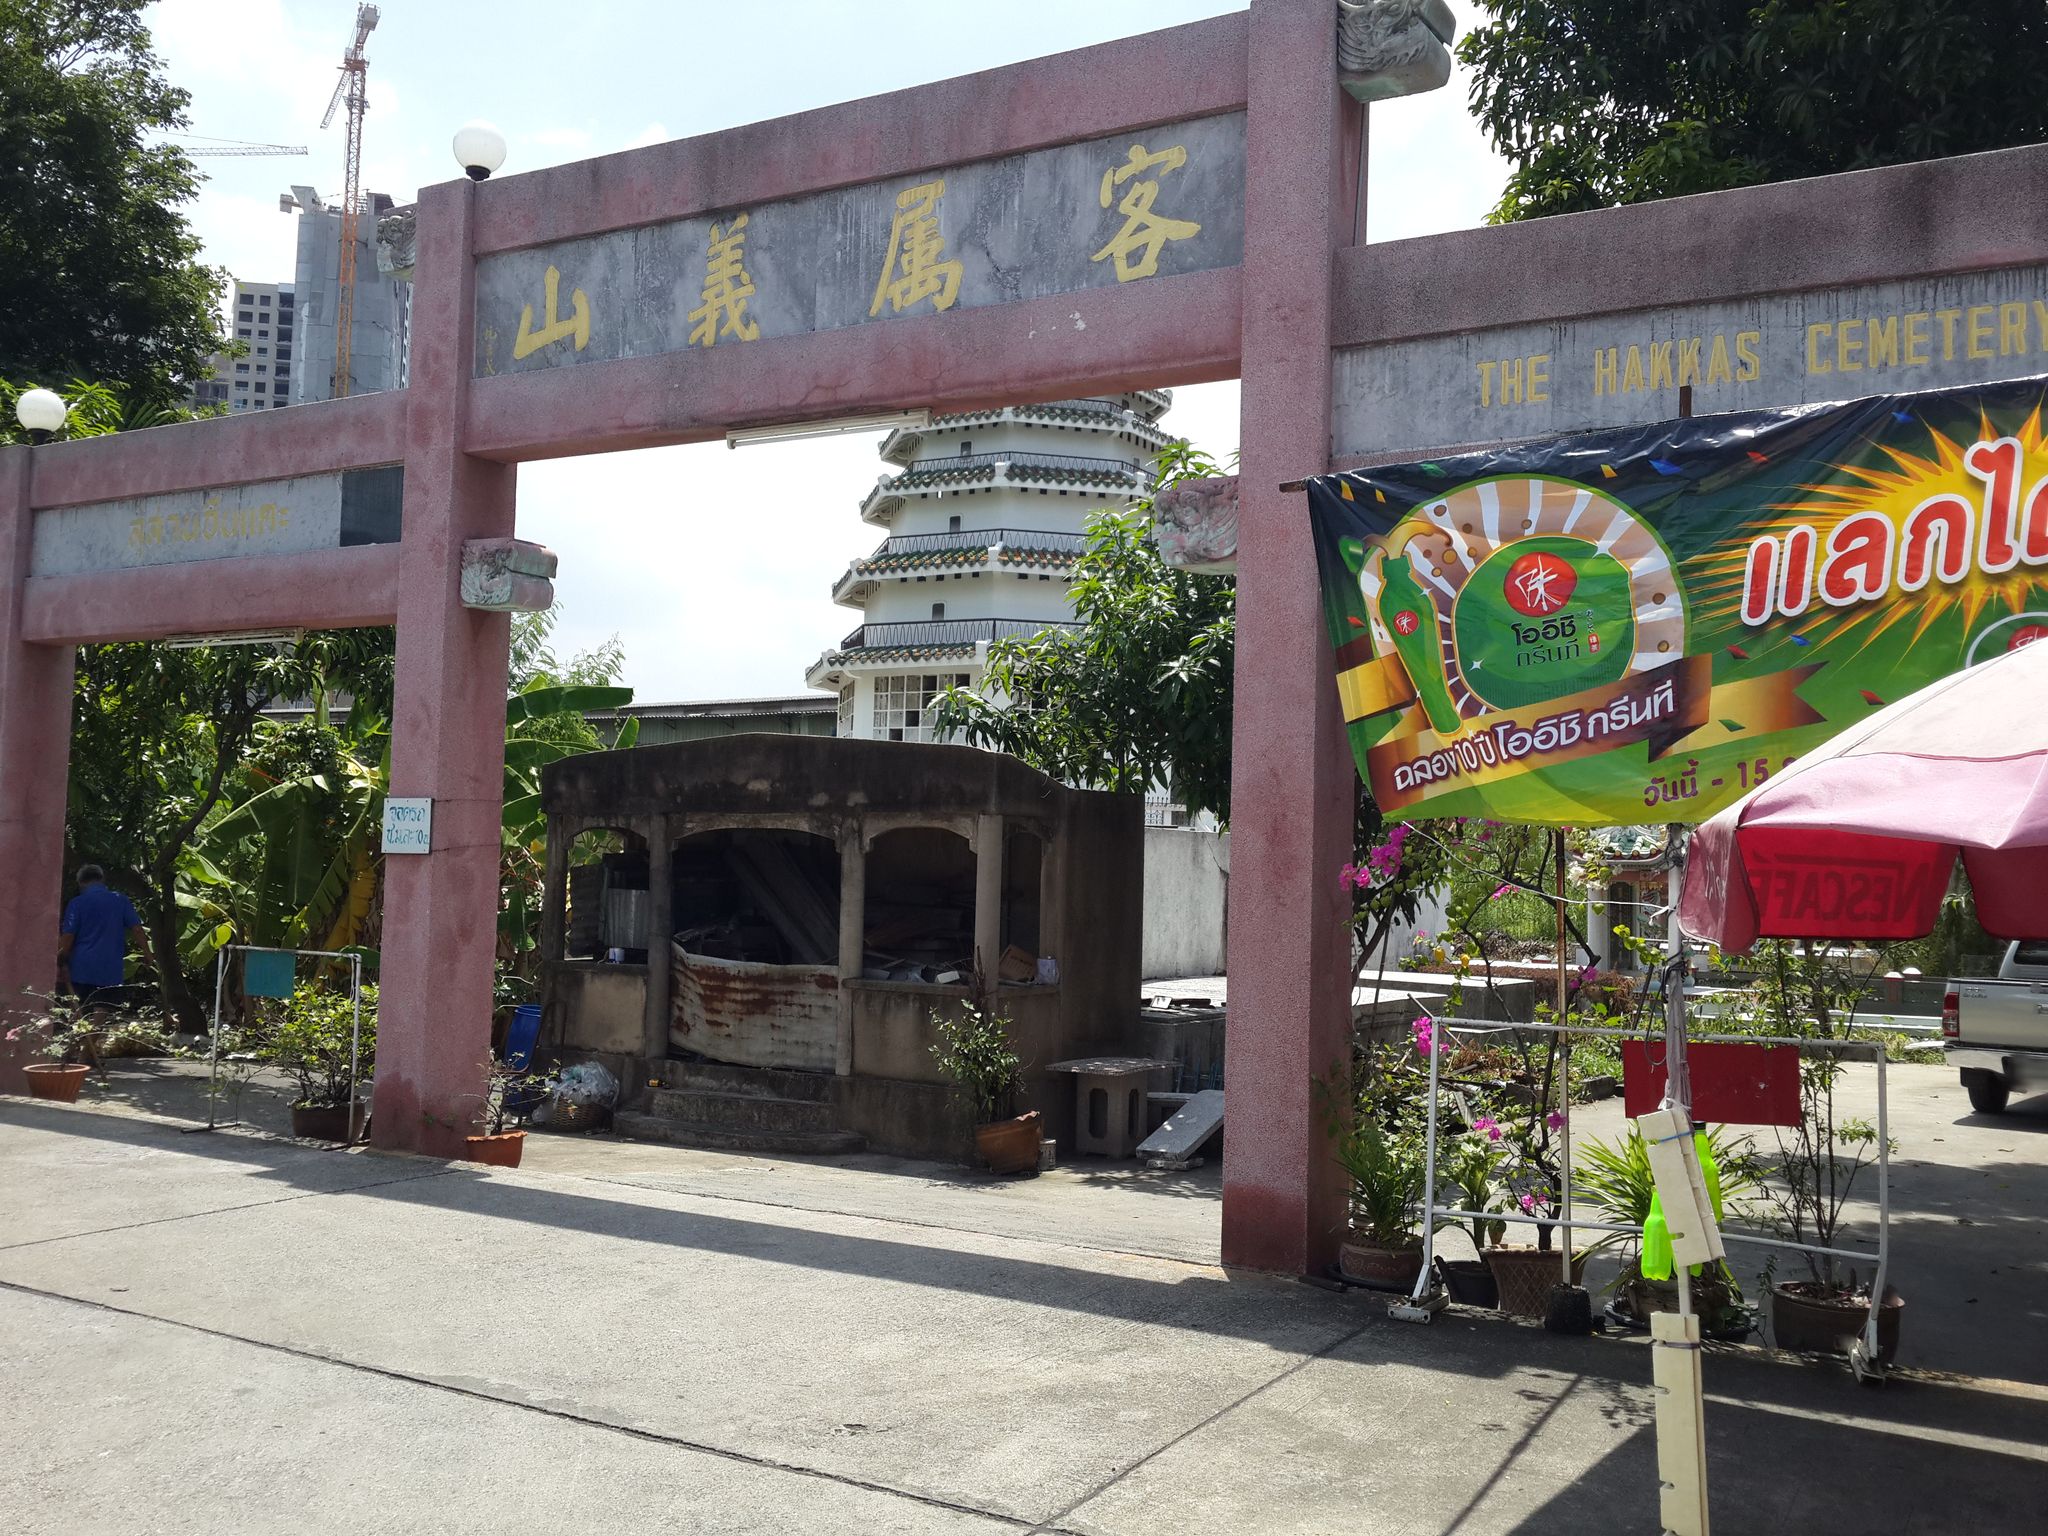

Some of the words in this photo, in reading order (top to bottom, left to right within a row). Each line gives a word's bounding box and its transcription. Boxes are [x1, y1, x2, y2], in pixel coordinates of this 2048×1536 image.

[1477, 354, 1550, 408] THE
[1595, 331, 1761, 397] HAKKAS
[1808, 300, 2048, 376] CEMETERY
[1511, 614, 1577, 646] โออิชิ
[1517, 638, 1580, 667] กรีนที
[1493, 712, 1582, 760] โออิชิ
[1587, 679, 1675, 739] กรีนที
[1644, 758, 1699, 807] วันนี้
[1736, 758, 1770, 788] 15
